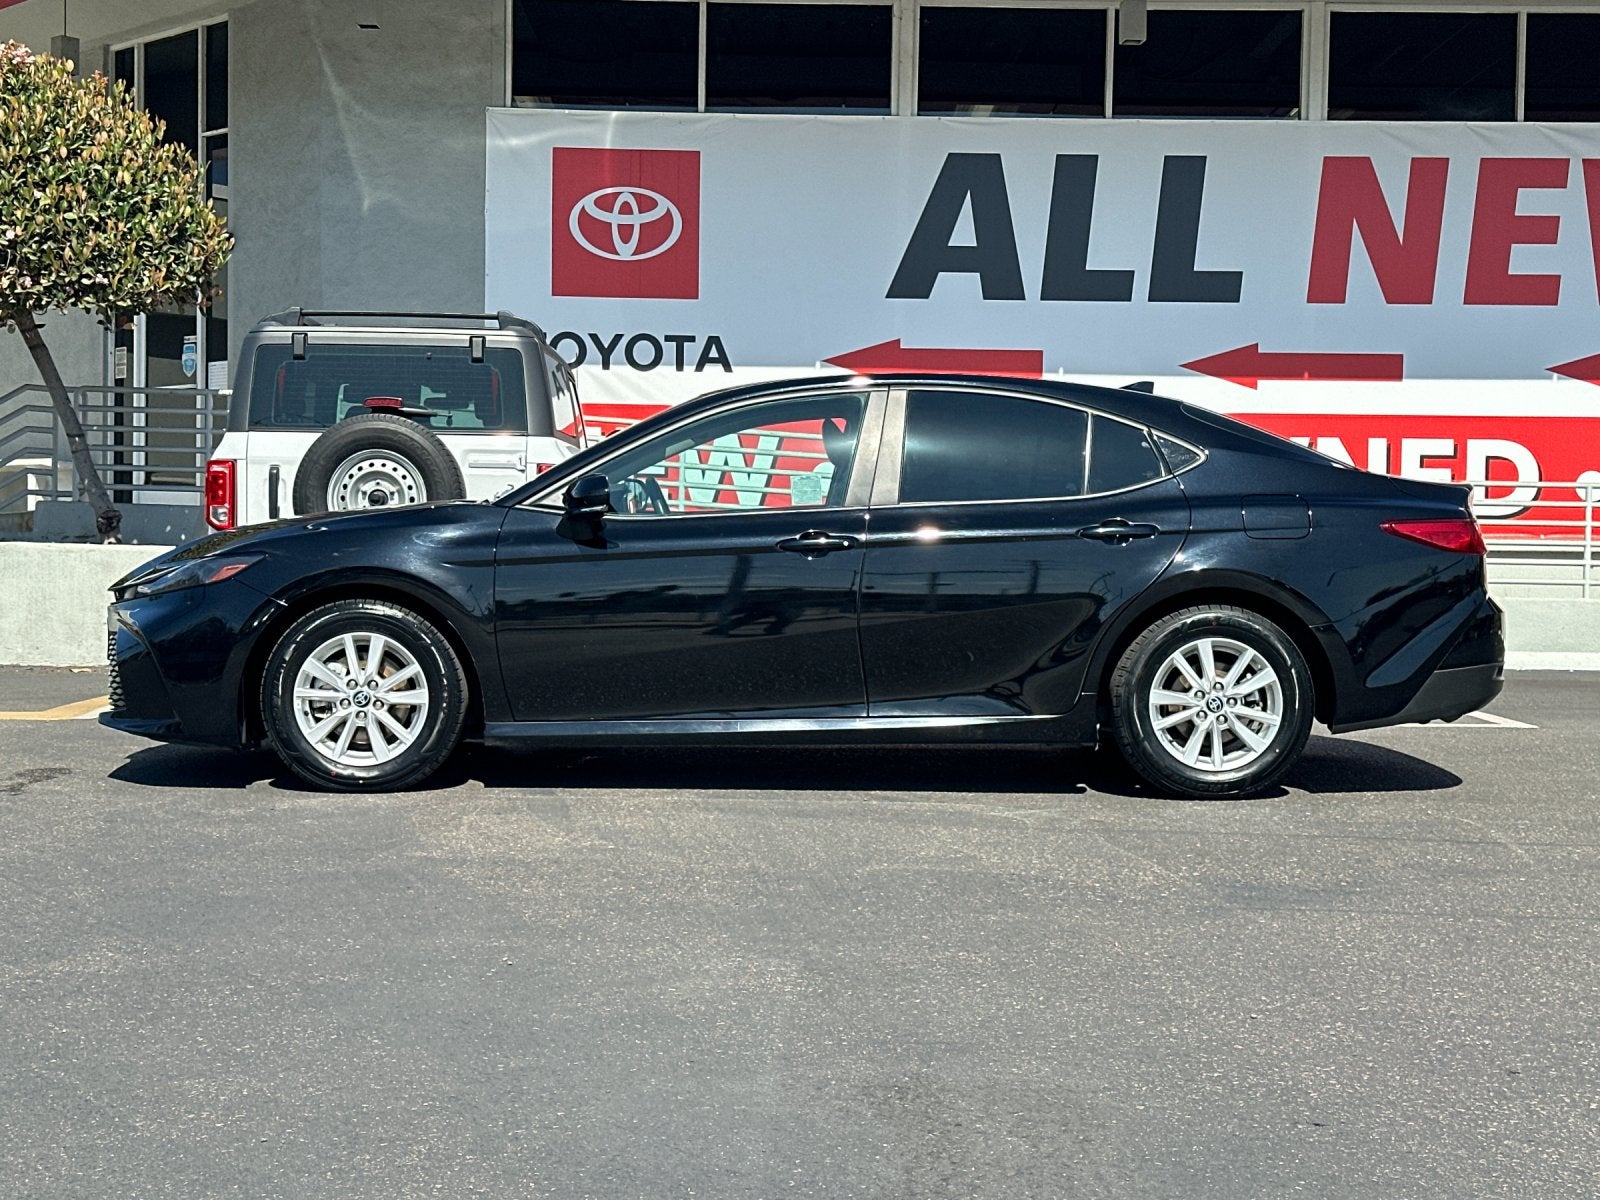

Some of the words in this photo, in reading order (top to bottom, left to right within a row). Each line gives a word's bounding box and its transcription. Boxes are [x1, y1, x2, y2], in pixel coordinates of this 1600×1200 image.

[885, 152, 1243, 303] ALL
[1306, 156, 1600, 306] NE
[543, 331, 733, 373] OYOTA
